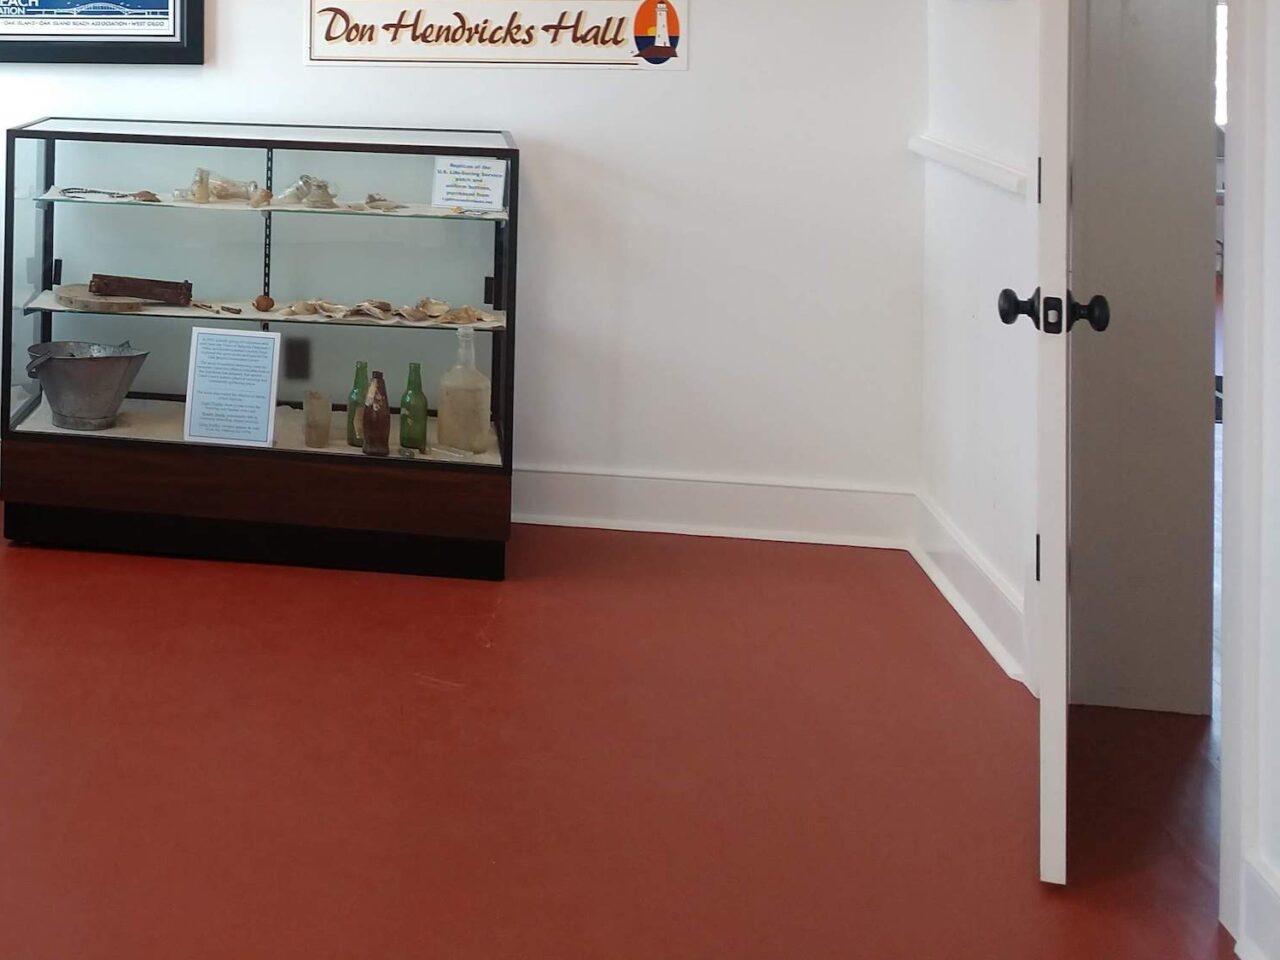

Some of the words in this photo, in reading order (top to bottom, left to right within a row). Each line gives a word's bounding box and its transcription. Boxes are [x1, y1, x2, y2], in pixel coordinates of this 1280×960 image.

[317, 7, 375, 43] Don
[381, 9, 535, 45] Hendricks
[541, 10, 627, 46] Hall
